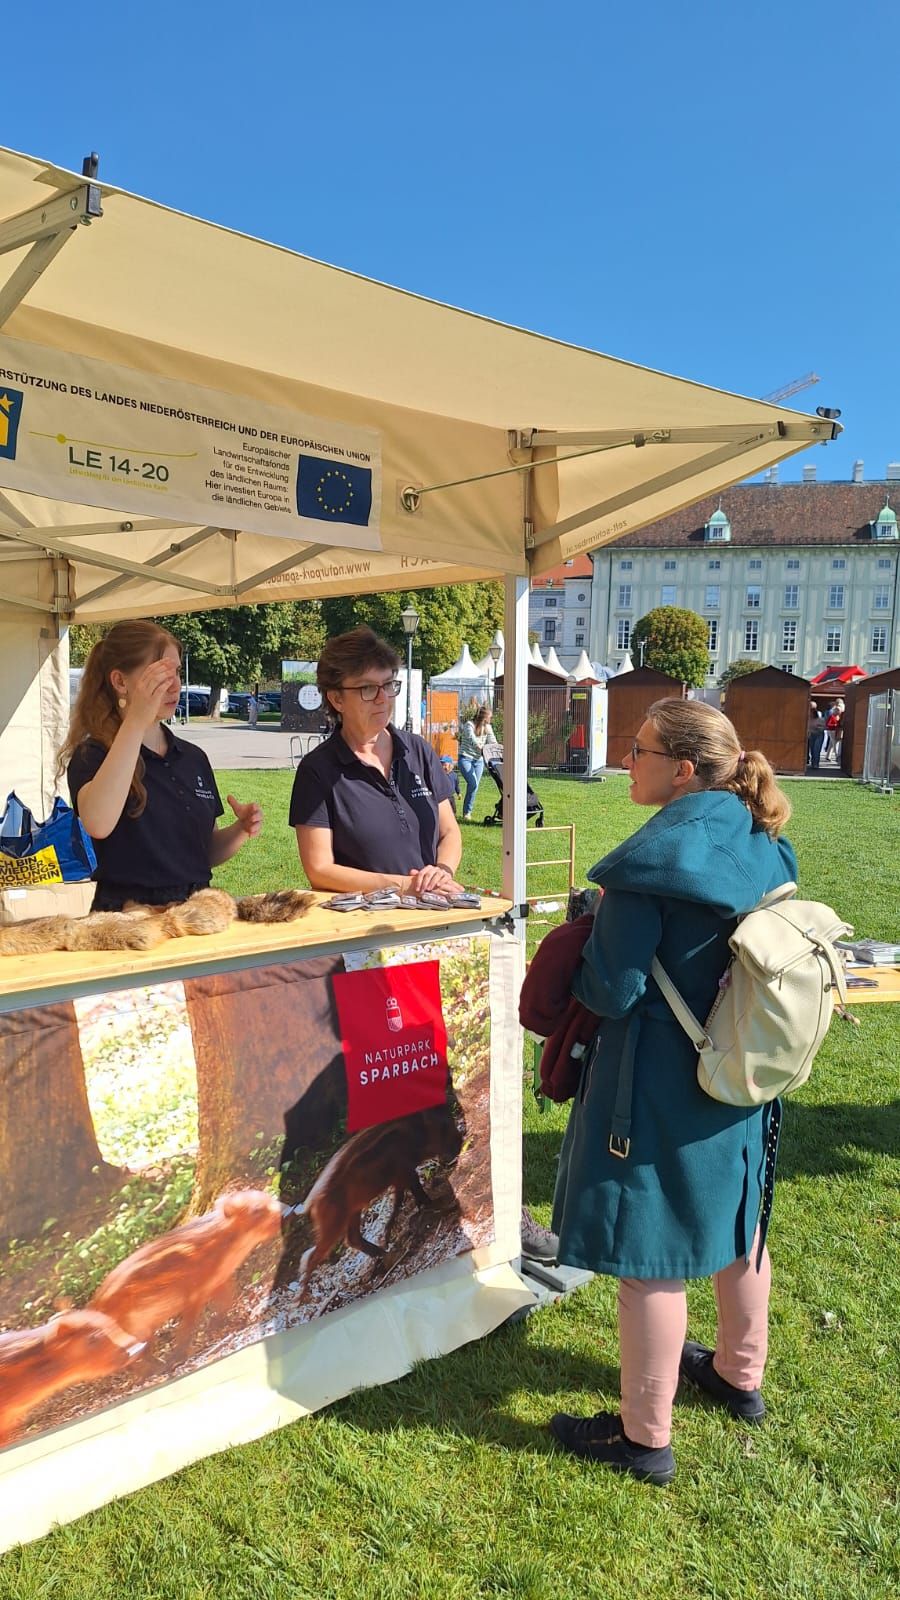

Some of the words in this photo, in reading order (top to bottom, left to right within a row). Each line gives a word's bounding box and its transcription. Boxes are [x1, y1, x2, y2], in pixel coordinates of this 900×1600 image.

[70, 385, 92, 398] DES
[95, 391, 137, 409] LANDES
[139, 401, 236, 432] NIEDERÖSTERREICH
[238, 425, 258, 437] UND
[260, 430, 279, 442] DER
[280, 435, 345, 456] EUROPÄISCHEN
[346, 450, 371, 462] UNION
[213, 446, 290, 471] Landwirtschaftsfonds
[242, 442, 292, 460] Europäischer
[68, 446, 103, 469] LE
[109, 455, 170, 482] 14-20
[223, 460, 233, 469] für
[234, 463, 246, 473] die
[247, 468, 289, 483] Entwicklung
[209, 469, 225, 480] des
[226, 472, 262, 487] ländlichen
[205, 479, 222, 491] Hier
[223, 483, 256, 497] investiert
[257, 490, 282, 503] Europa
[211, 492, 225, 502] die
[225, 494, 263, 509] ländlichen
[16, 855, 37, 867] BIN
[364, 1039, 431, 1065] NATURPARK
[359, 1053, 439, 1085] SPARBACH
